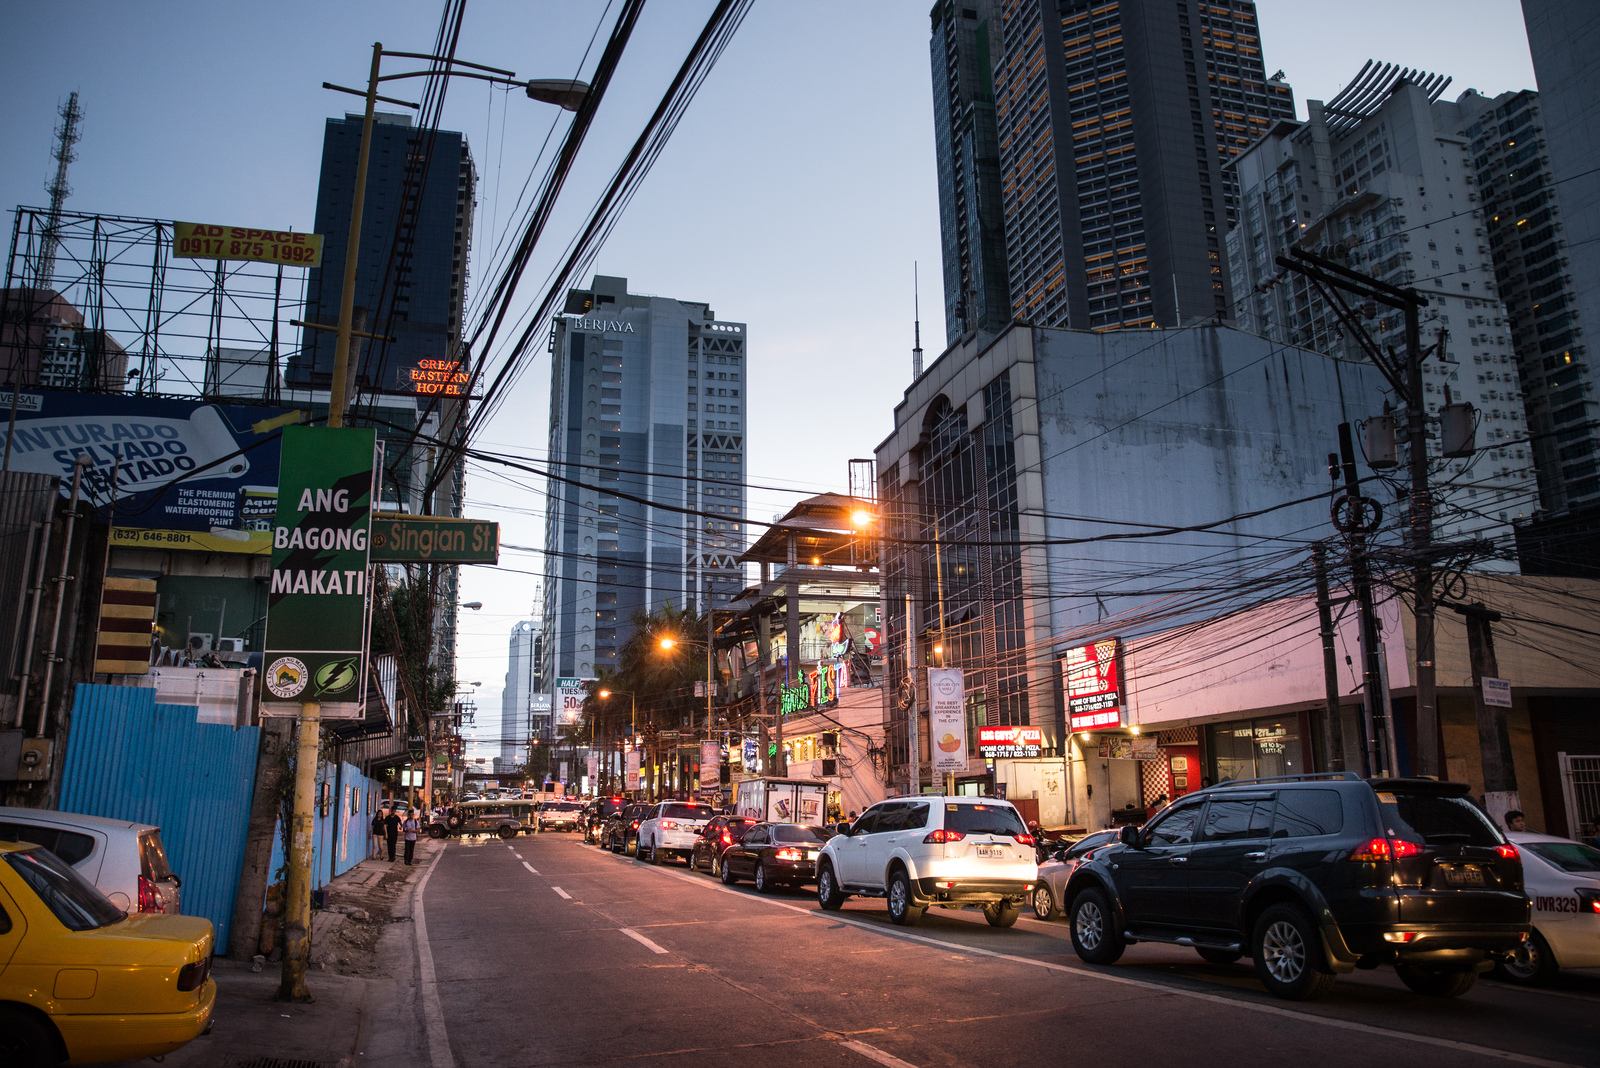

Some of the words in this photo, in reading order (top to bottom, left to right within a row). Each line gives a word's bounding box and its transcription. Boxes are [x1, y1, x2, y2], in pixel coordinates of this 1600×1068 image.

[192, 224, 224, 237] AD
[230, 228, 306, 244] SPACE
[180, 238, 224, 255] 0917
[230, 241, 264, 257] 875
[271, 244, 315, 262] 1992
[574, 318, 634, 333] BERJAYA
[0, 393, 40, 405] VESAL
[179, 489, 195, 497] THE
[196, 489, 236, 500] PREMIUM
[297, 488, 349, 513] ANG
[178, 498, 235, 508] ELASTOMERIC
[165, 506, 234, 517] WATERPROOFING
[209, 517, 233, 526] PAINT
[113, 529, 140, 542] (632)
[143, 532, 191, 543] 646-8801
[274, 526, 367, 551] BAGONG
[390, 522, 465, 558] Singian
[472, 524, 494, 552] St.
[270, 569, 364, 595] MAKATI
[561, 679, 579, 687] HALF
[1536, 896, 1578, 913] UVR329
